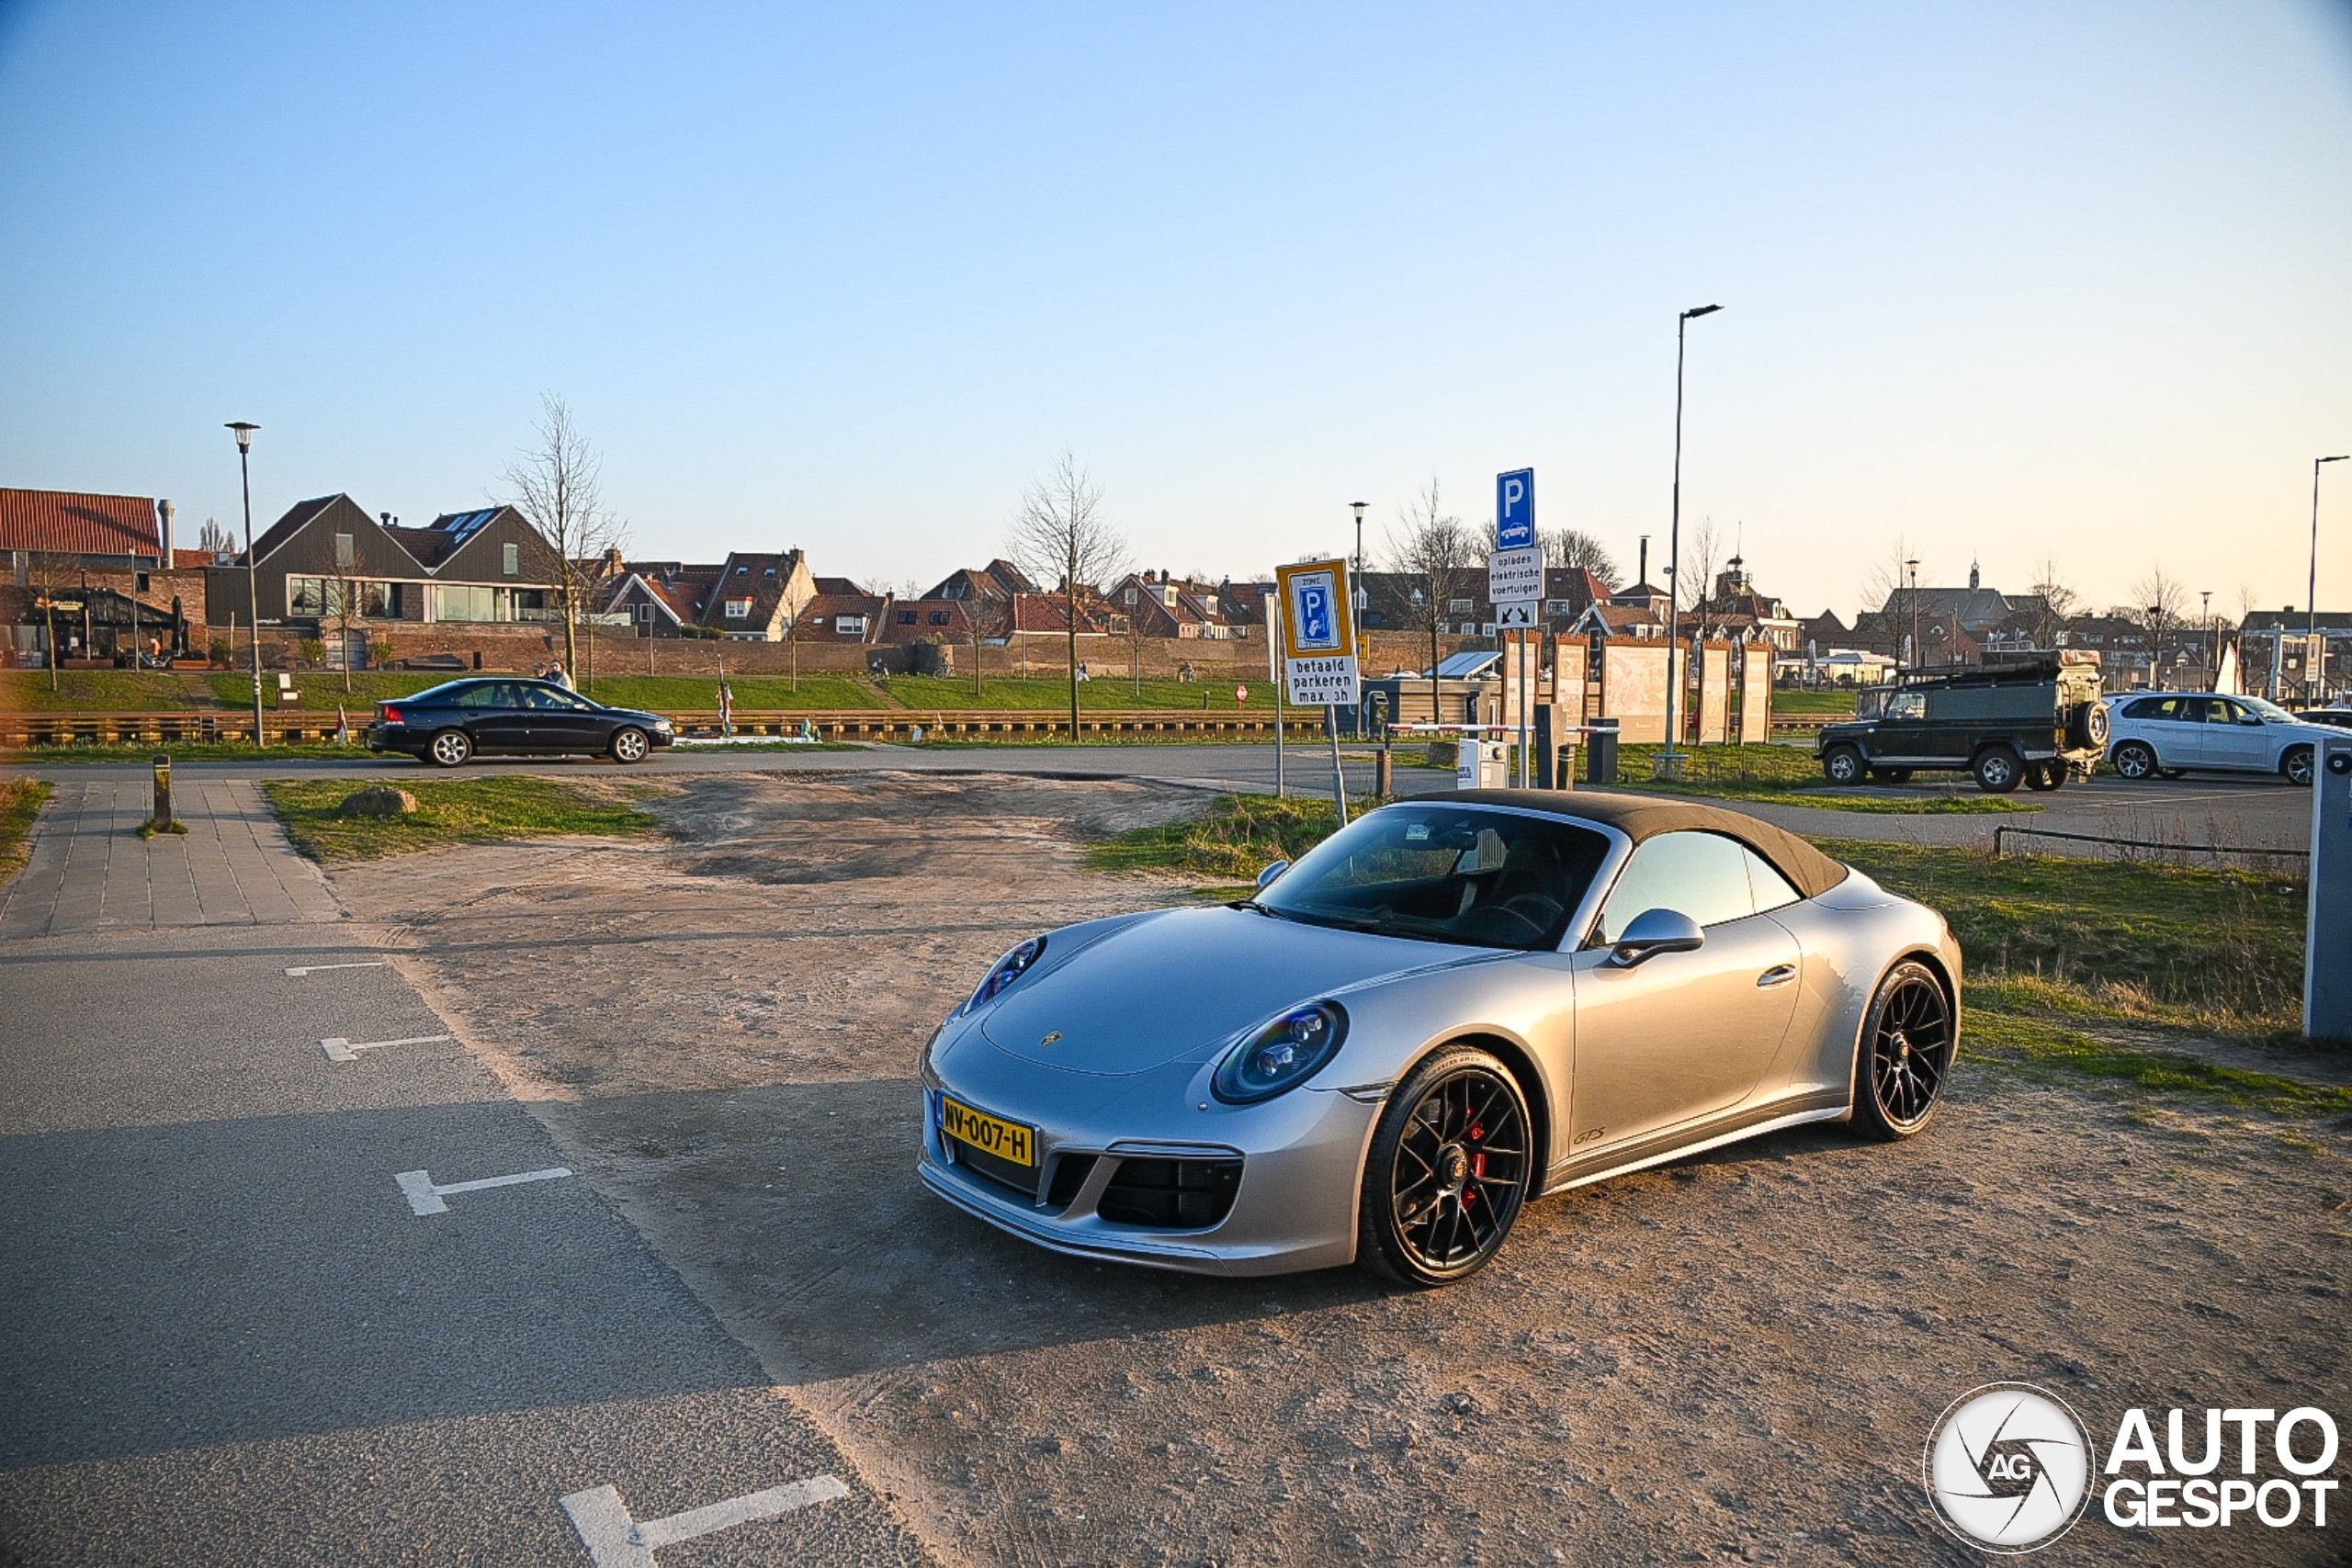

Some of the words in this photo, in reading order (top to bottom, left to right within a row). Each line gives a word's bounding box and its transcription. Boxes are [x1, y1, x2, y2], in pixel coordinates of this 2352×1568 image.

[1505, 479, 1523, 518] P
[1498, 555, 1532, 567] opladen
[1491, 569, 1540, 581] elektrische
[1492, 583, 1538, 595] voertuigen
[1306, 592, 1320, 617] P
[1296, 658, 1345, 673] betaald
[1294, 673, 1351, 691] parkeren
[1299, 692, 1329, 703] max.
[1334, 688, 1348, 702] 3h
[944, 1101, 1025, 1159] NV-007-H
[1574, 1126, 1606, 1145] GTS
